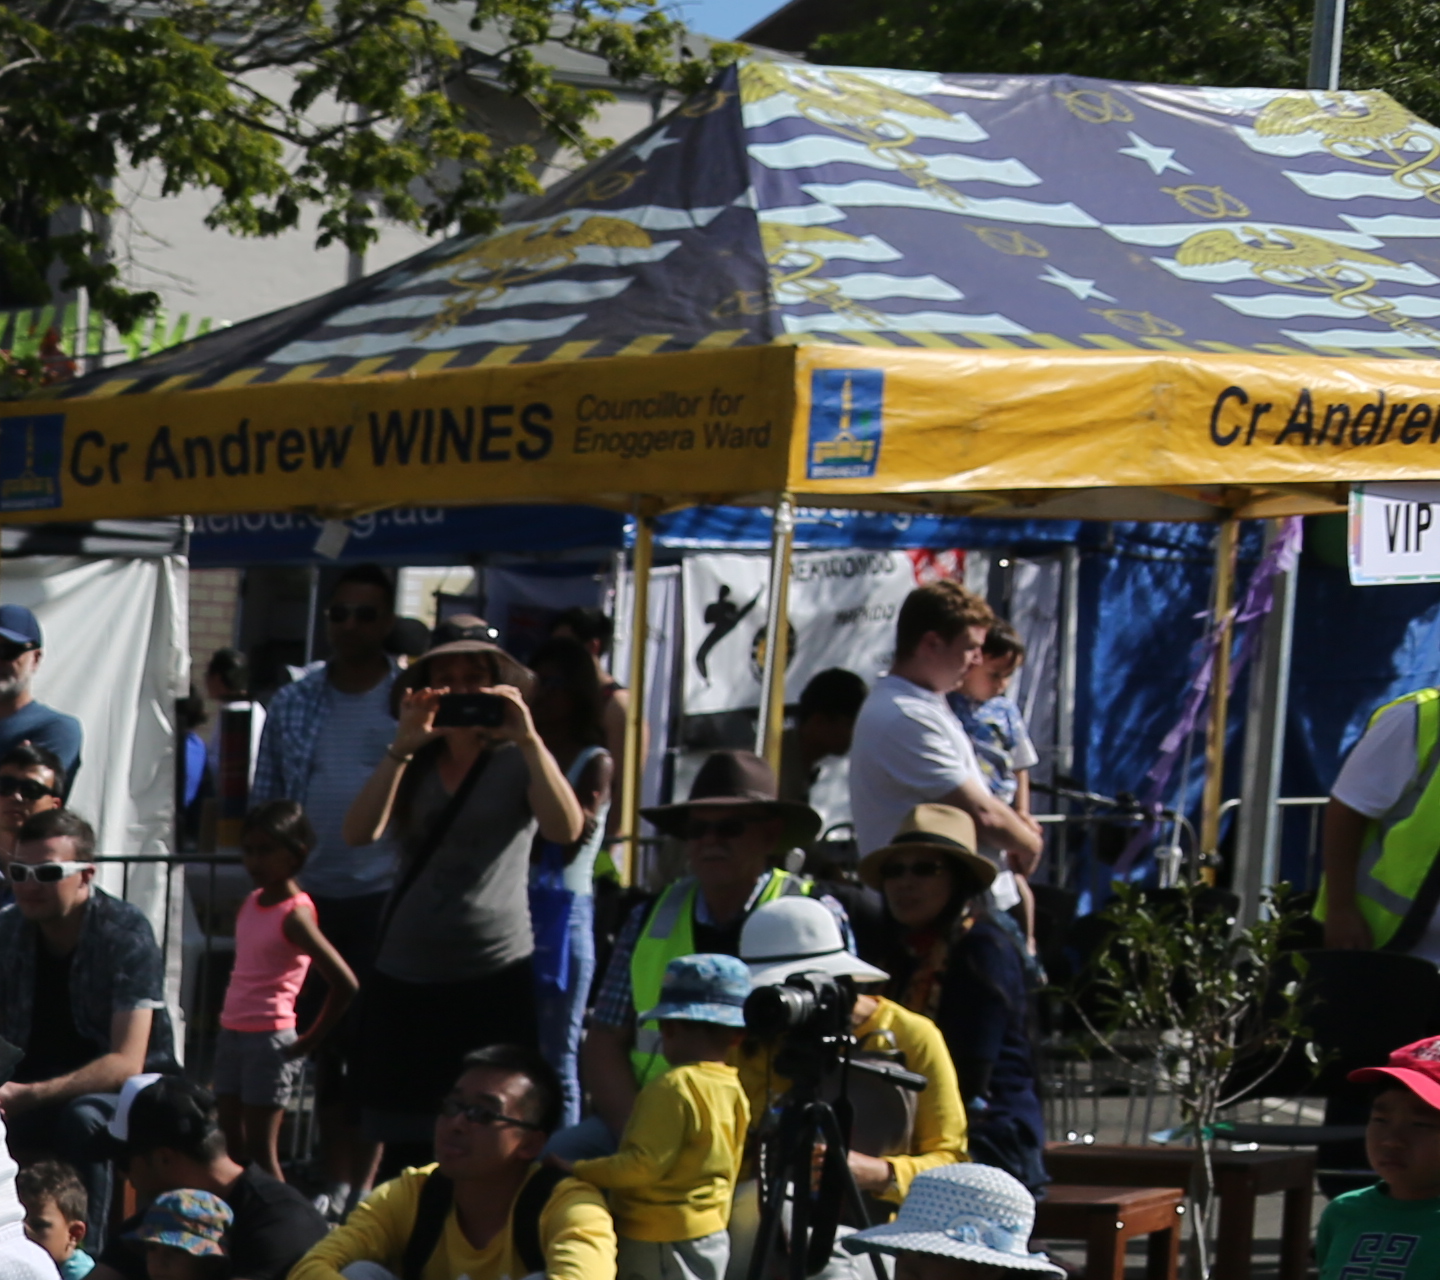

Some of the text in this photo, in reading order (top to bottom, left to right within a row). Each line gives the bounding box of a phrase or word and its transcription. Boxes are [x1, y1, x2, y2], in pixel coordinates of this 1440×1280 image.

[576, 387, 745, 423] Councillor for
[1210, 385, 1440, 447] Cr Andre
[68, 401, 556, 487] Cr Andrew WINES
[573, 421, 773, 460] Enoggera Ward
[1384, 501, 1433, 554] VIP
